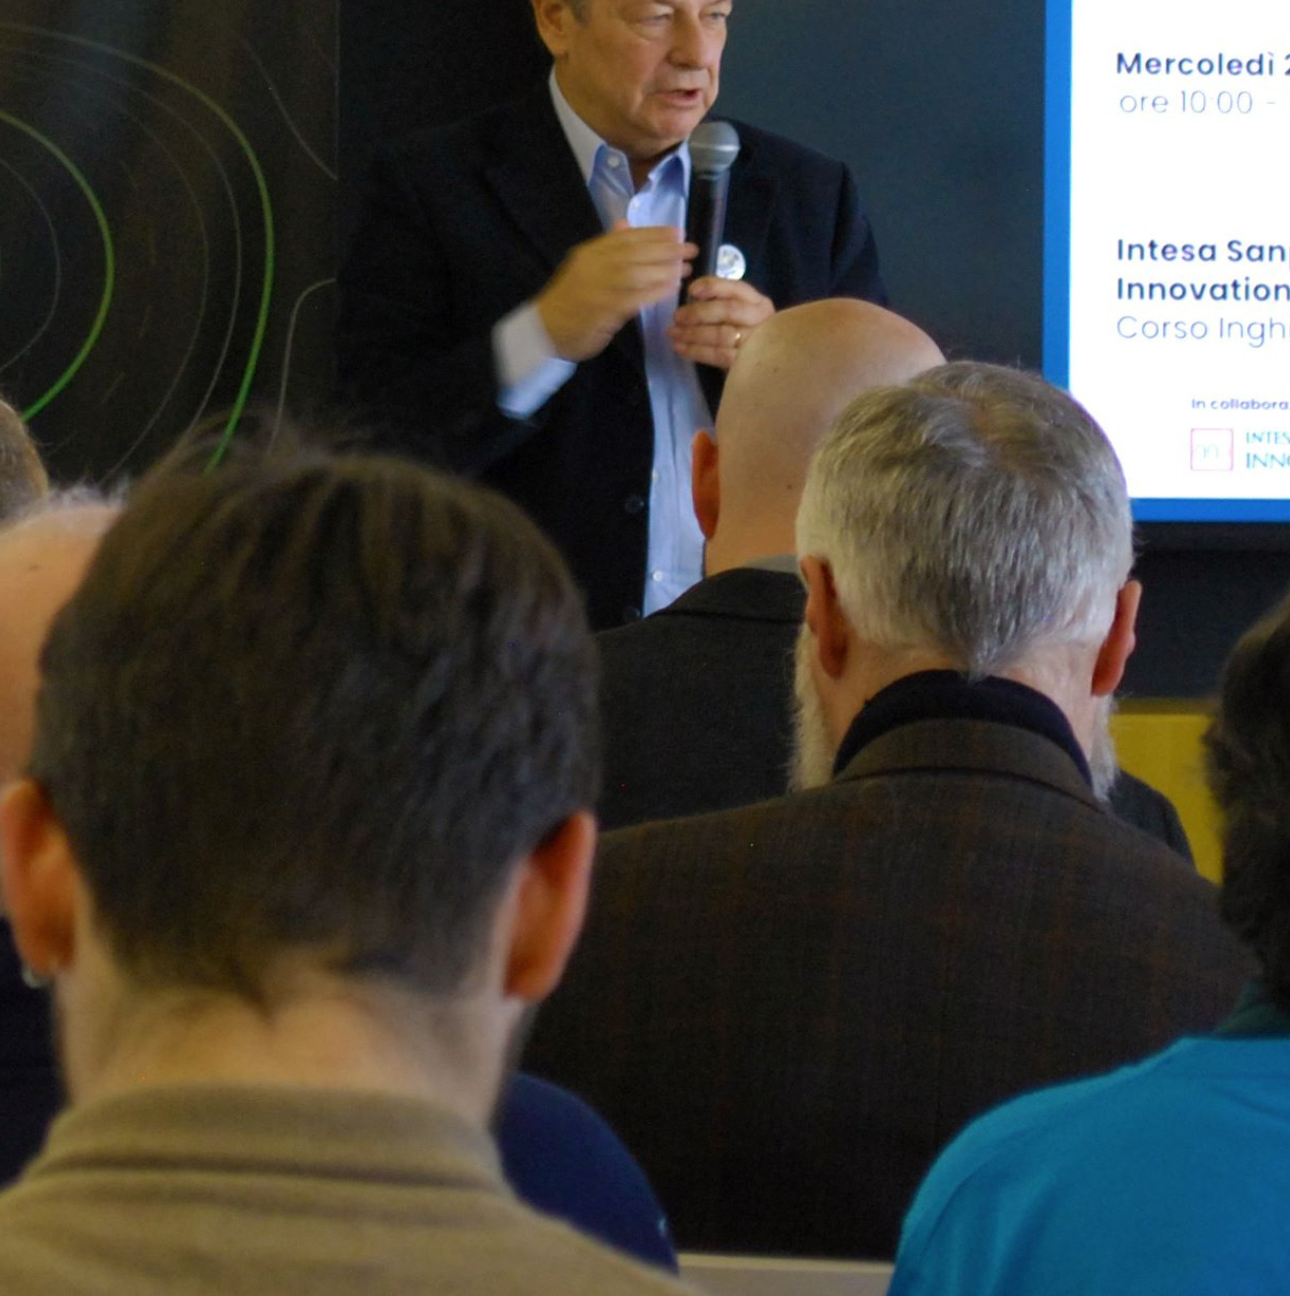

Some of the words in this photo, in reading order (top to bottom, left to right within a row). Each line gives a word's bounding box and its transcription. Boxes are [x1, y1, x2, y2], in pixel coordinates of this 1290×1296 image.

[1116, 51, 1274, 76] Mercoledì
[1119, 94, 1169, 114] ore
[1117, 238, 1217, 262] Intesa
[1116, 315, 1209, 340] Corso
[1191, 398, 1206, 409] In
